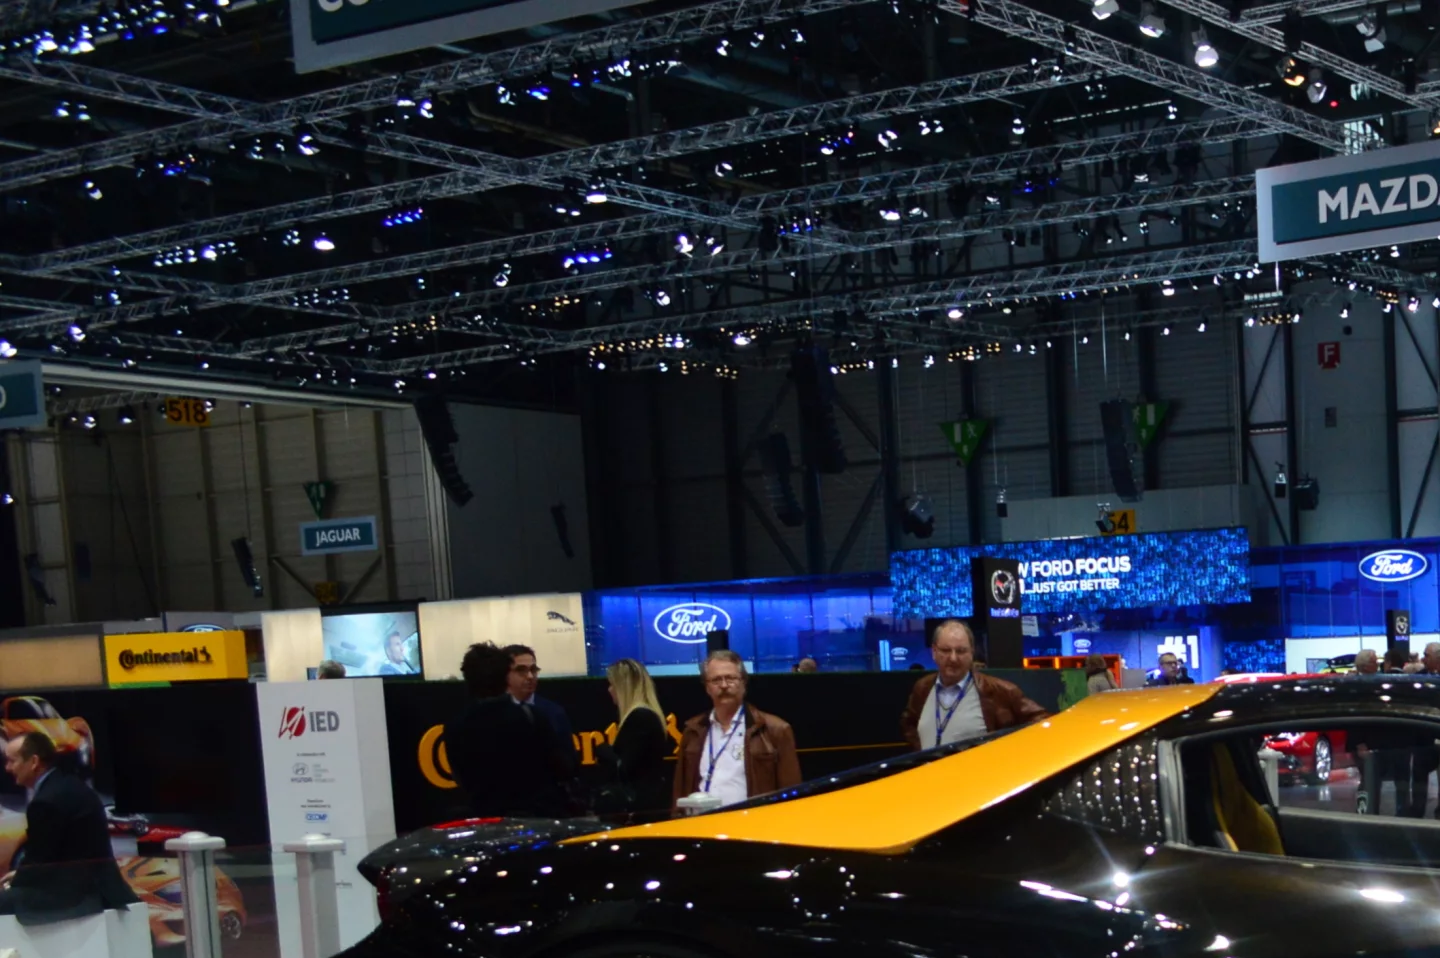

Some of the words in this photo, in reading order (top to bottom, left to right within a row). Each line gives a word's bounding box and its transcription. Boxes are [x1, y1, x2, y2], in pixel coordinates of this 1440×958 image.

[1324, 344, 1335, 363] F
[168, 402, 208, 424] 518
[316, 527, 361, 547] JAGUAR
[1031, 559, 1074, 577] FORD
[1075, 555, 1132, 574] FOCUS
[1371, 554, 1414, 576] Ford
[1057, 580, 1078, 592] GOT
[1081, 578, 1120, 591] BETTER
[667, 608, 718, 637] Ford
[119, 647, 199, 670] Continental
[309, 711, 340, 732] IED
